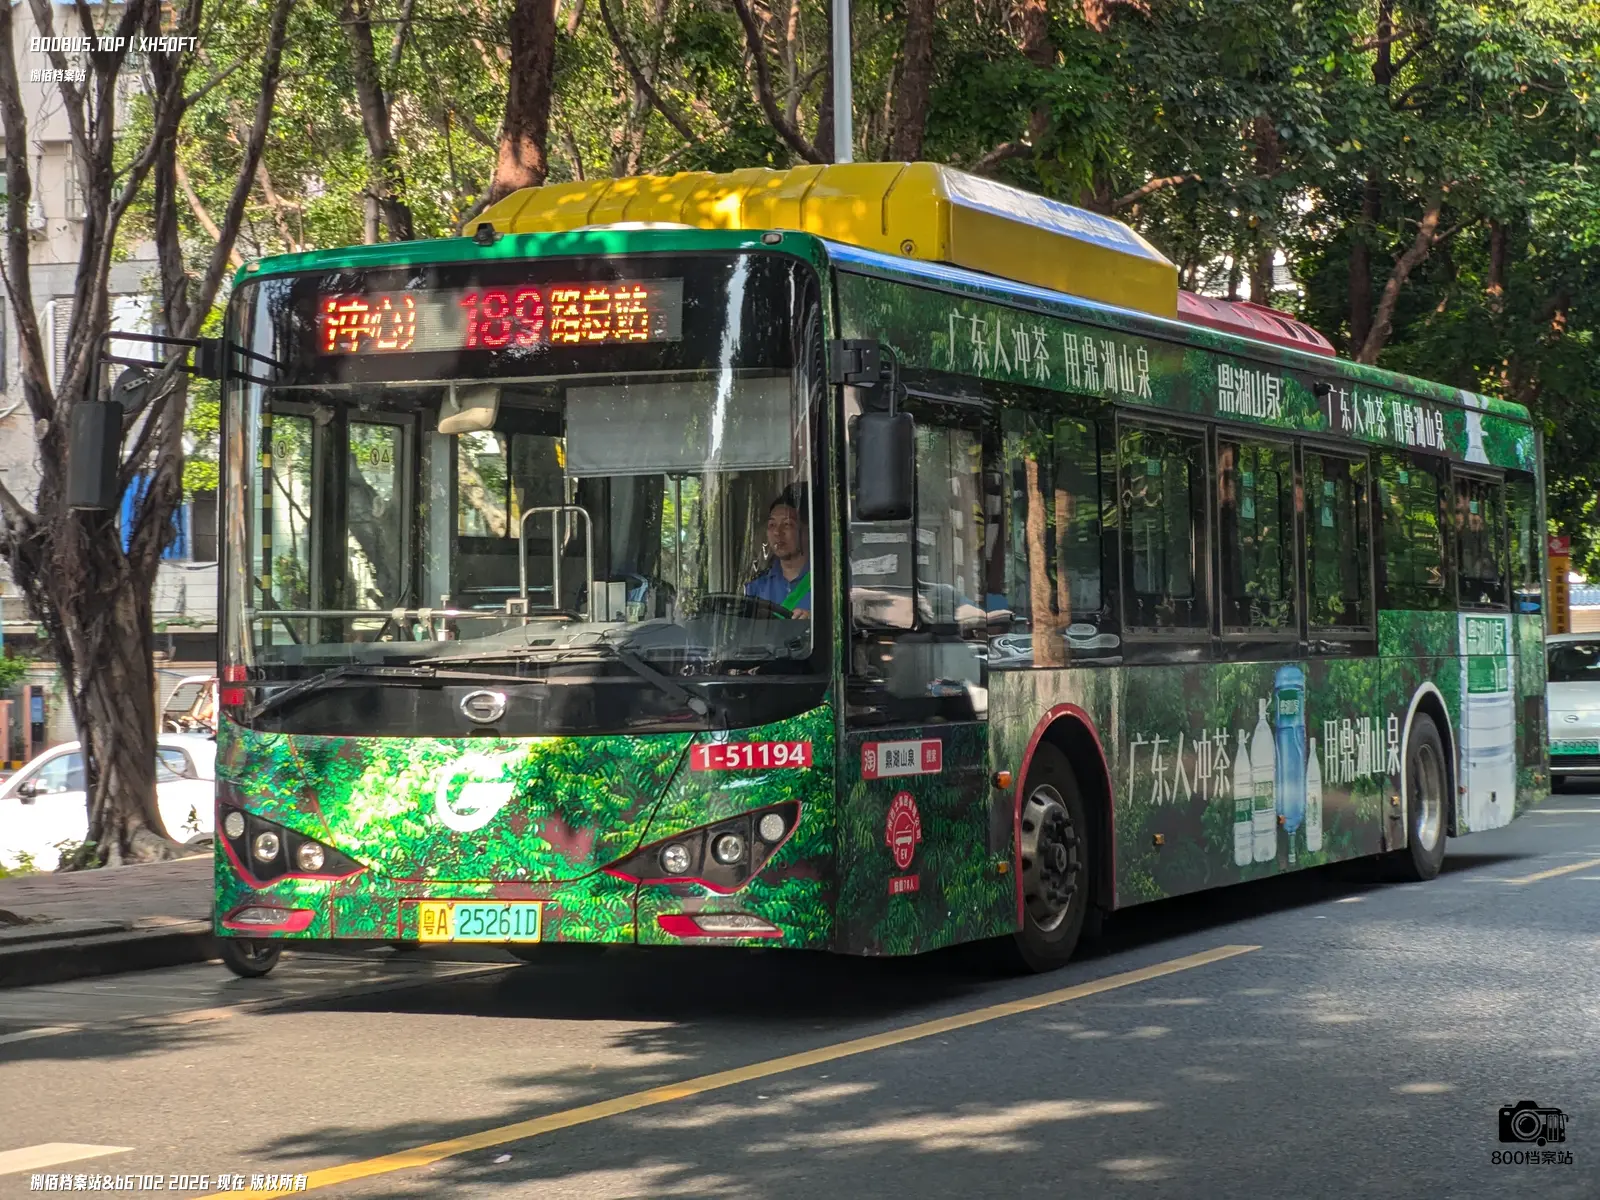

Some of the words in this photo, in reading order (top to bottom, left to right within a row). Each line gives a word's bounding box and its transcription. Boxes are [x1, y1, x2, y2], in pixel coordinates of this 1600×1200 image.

[461, 289, 545, 347] 189
[550, 284, 648, 343] 路总站
[949, 307, 1050, 382] 广东人冲茶
[1063, 331, 1153, 400] 用鼎湖山泉
[1217, 362, 1283, 420] 鼎湖山泉
[1391, 399, 1447, 452] 用鼎湖山泉
[699, 743, 806, 768] 1-51194
[885, 748, 915, 769] 鼎湖山泉
[1128, 727, 1231, 809] 广东人冲茶
[1323, 712, 1401, 784] 用鼎湖山泉
[459, 907, 538, 936] 25261D
